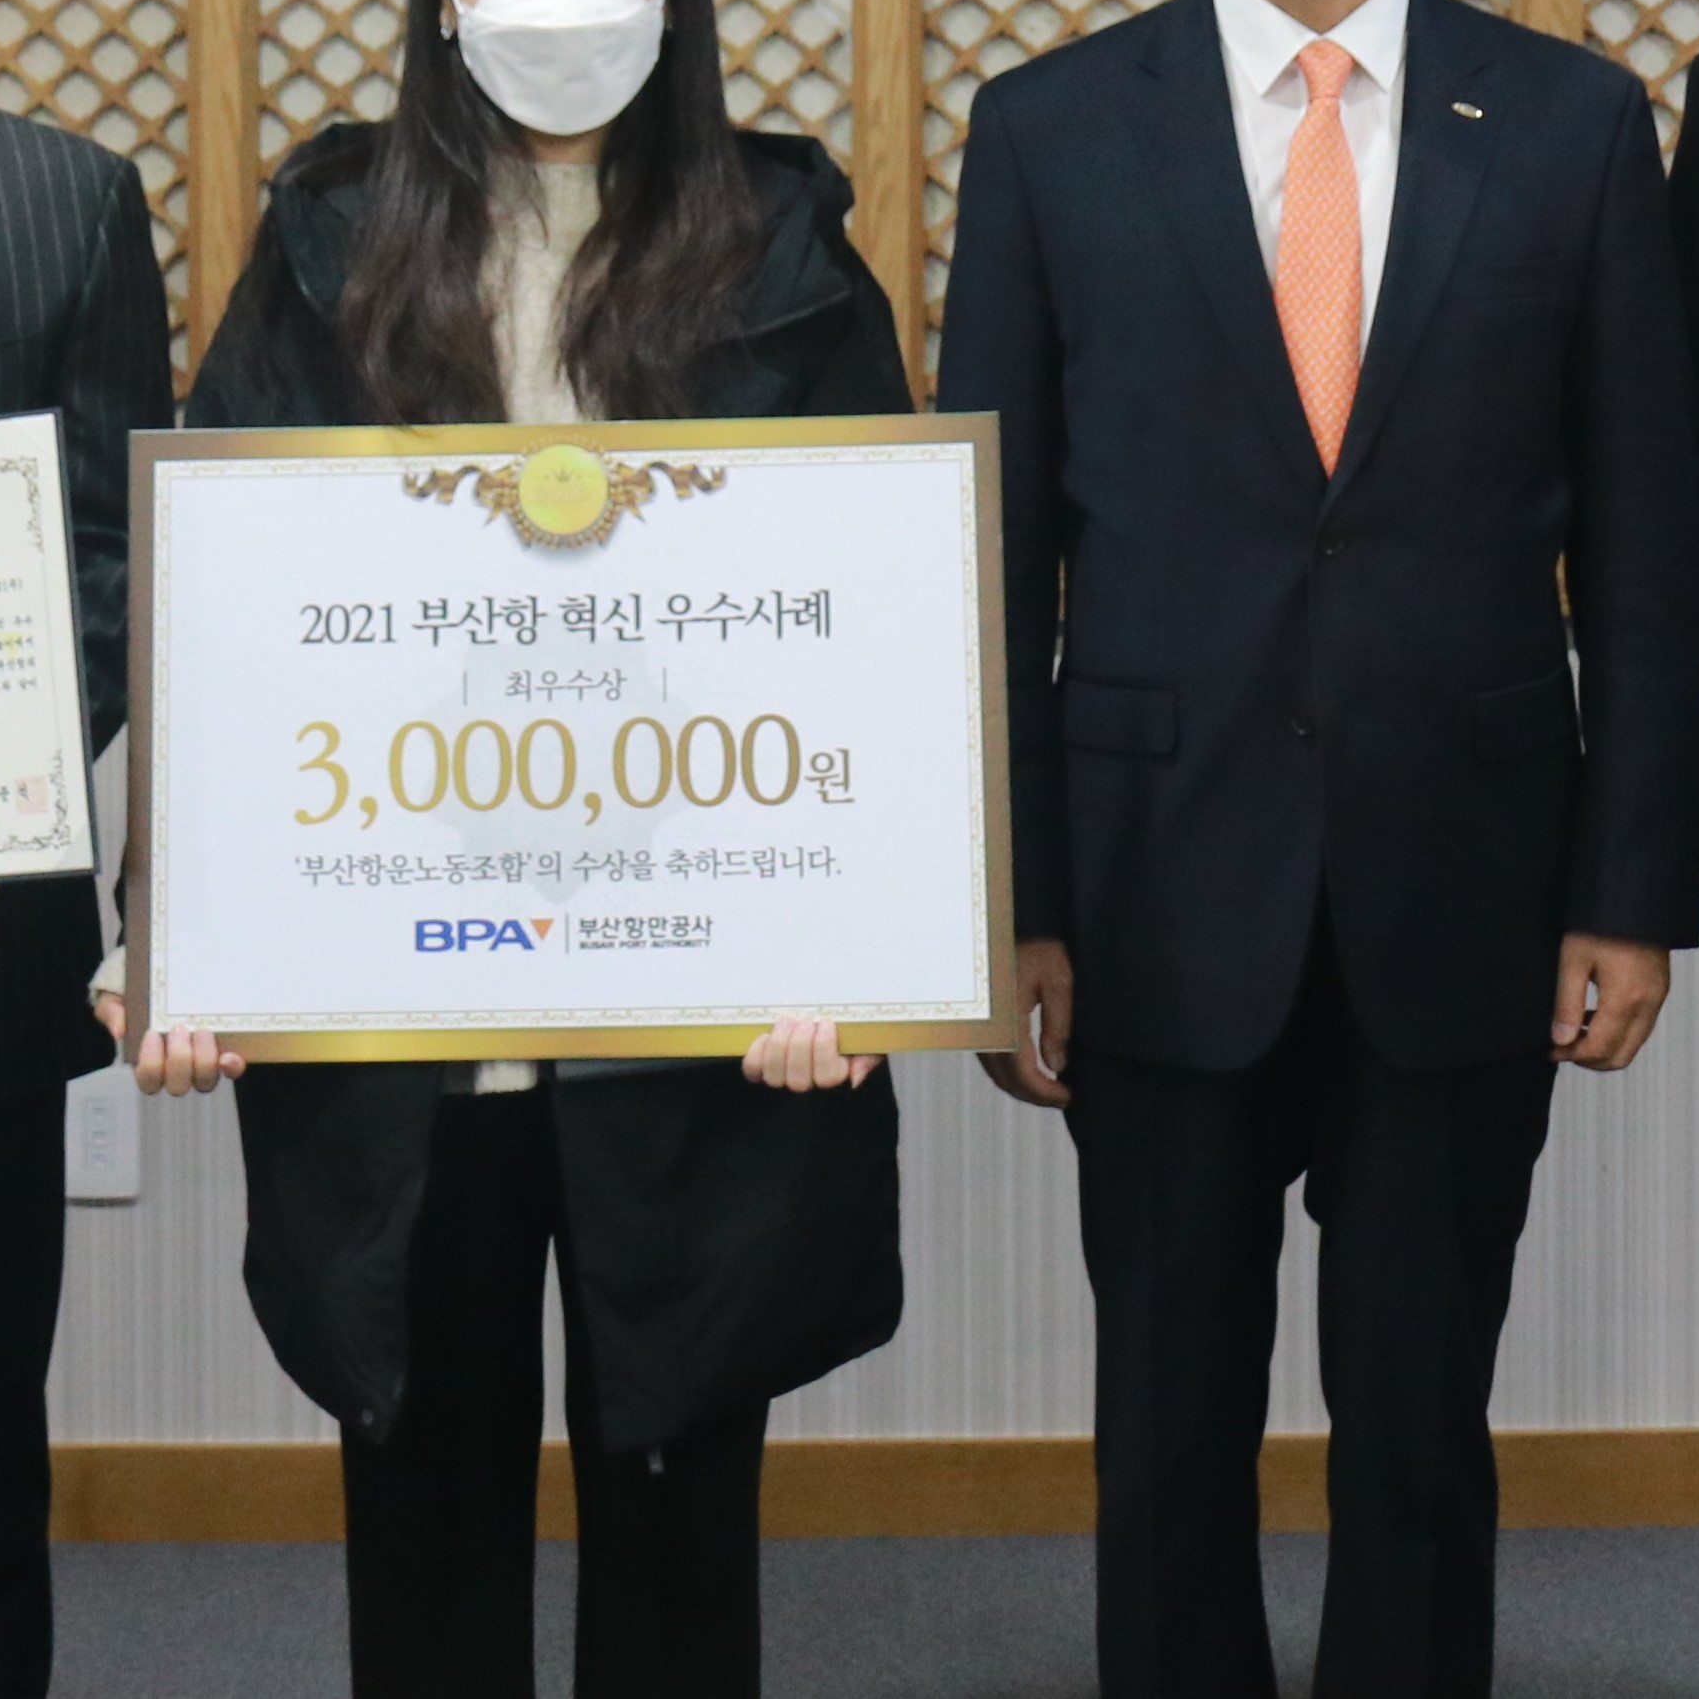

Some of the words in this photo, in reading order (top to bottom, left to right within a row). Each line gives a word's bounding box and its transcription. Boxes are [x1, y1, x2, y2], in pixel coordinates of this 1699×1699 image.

[300, 603, 396, 645] 2021
[412, 595, 548, 648] 부산항
[560, 593, 645, 645] 혁신
[657, 589, 831, 643] 우수사례
[505, 667, 628, 703] 최우수상
[294, 712, 855, 828] 3,000,000원
[571, 850, 658, 882] 수상을
[667, 844, 842, 881] 축하드립니다.
[414, 917, 536, 953] BPA
[577, 915, 712, 941] 부산항만공사
